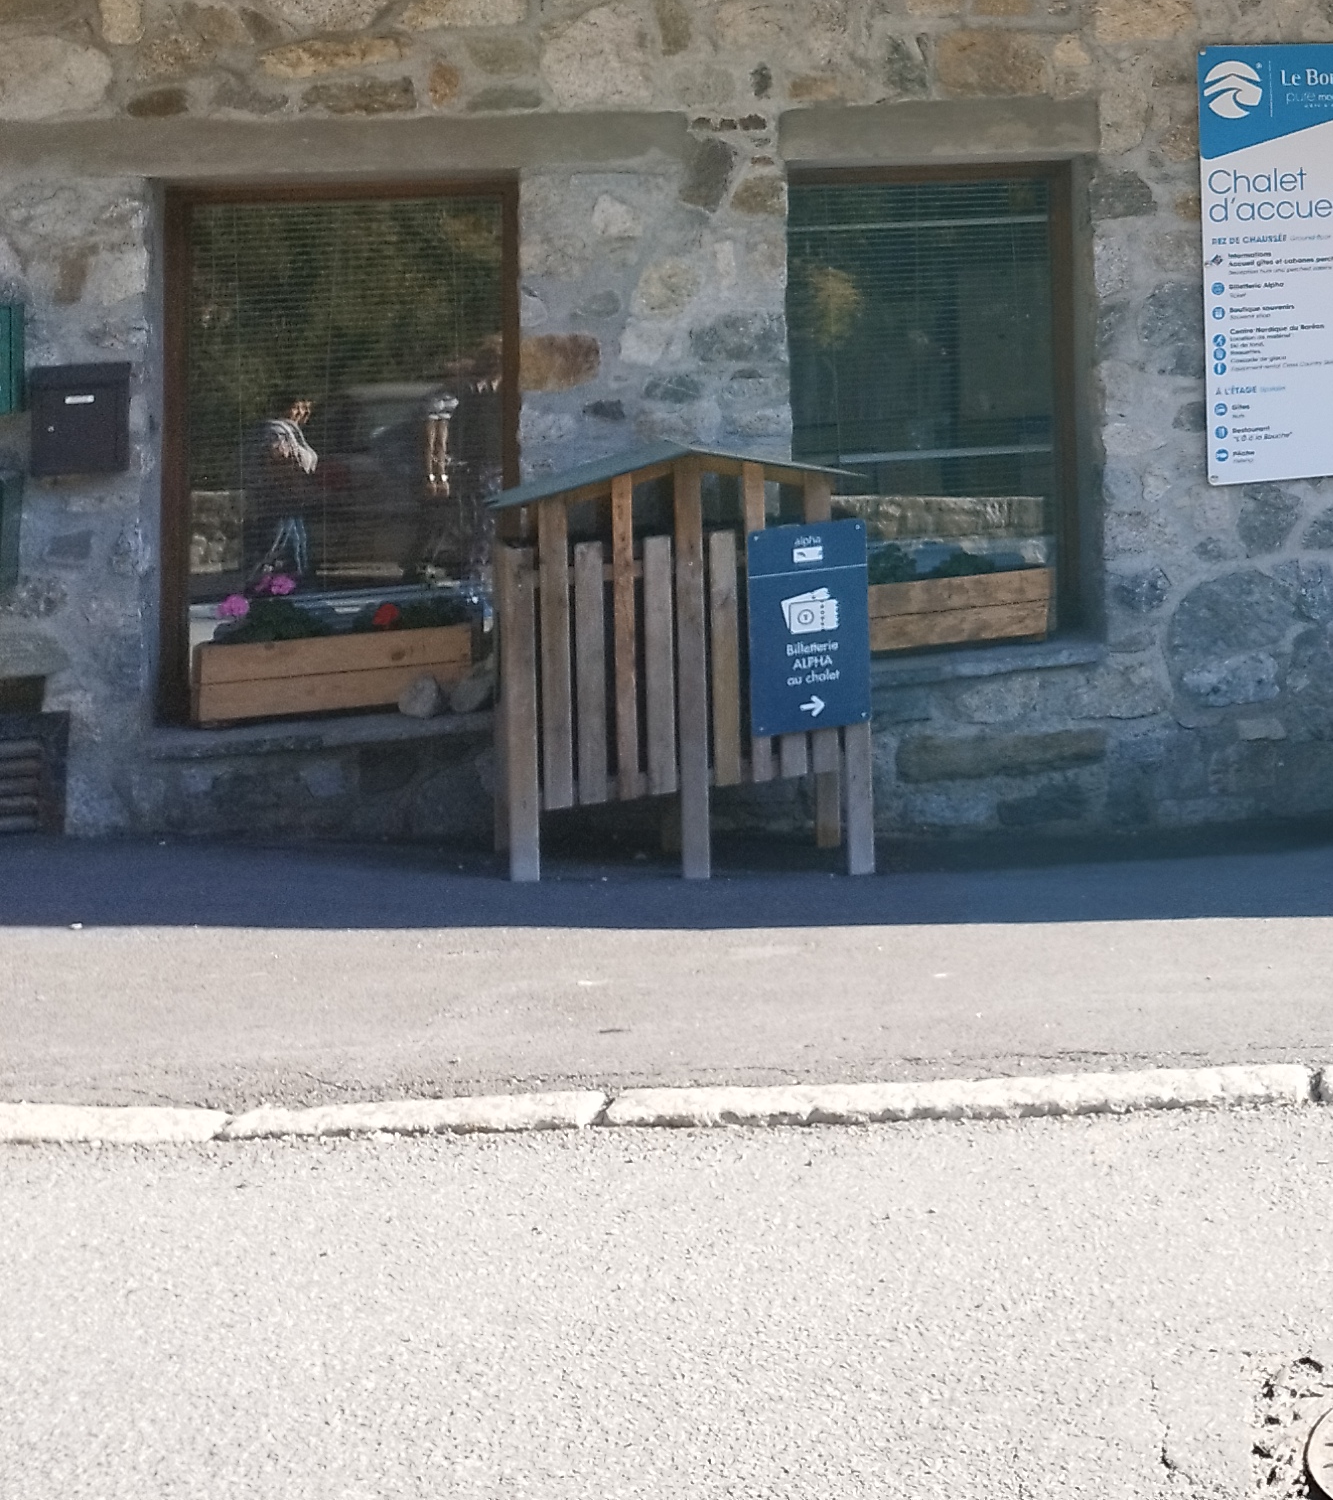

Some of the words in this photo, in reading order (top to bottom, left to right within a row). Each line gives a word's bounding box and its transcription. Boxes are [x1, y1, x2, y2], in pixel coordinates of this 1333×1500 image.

[1281, 69, 1301, 87] Le
[1286, 91, 1316, 105] pure
[1208, 167, 1307, 194] Chalet
[1211, 237, 1227, 245] REZ
[1229, 237, 1240, 245] DE
[1242, 234, 1287, 244] CHAUSSÉE
[786, 640, 839, 656] Billetterie
[793, 655, 833, 670] ALPHA
[787, 676, 802, 686] au
[806, 668, 840, 684] chalet
